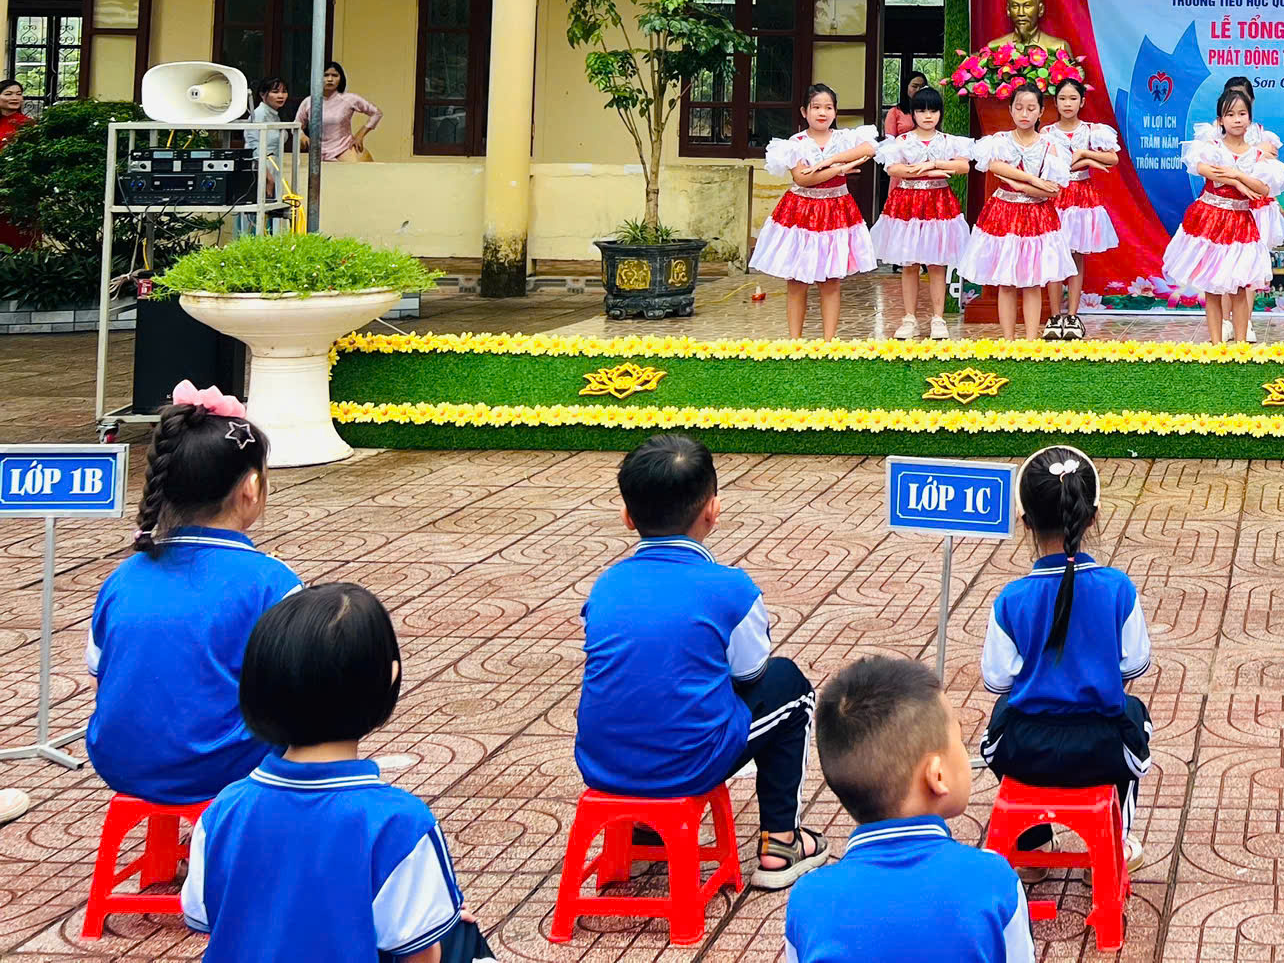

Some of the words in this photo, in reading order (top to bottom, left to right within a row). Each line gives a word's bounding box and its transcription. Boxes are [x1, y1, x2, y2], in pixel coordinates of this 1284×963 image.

[1210, 15, 1232, 39] LỄ
[1208, 46, 1241, 66] PHÁT
[1244, 47, 1279, 70] ĐỘNG
[1252, 76, 1276, 89] Sơn
[8, 459, 62, 496] LỚP
[69, 467, 103, 494] 1B
[907, 475, 956, 512] LỚP
[962, 486, 991, 514] 1C
